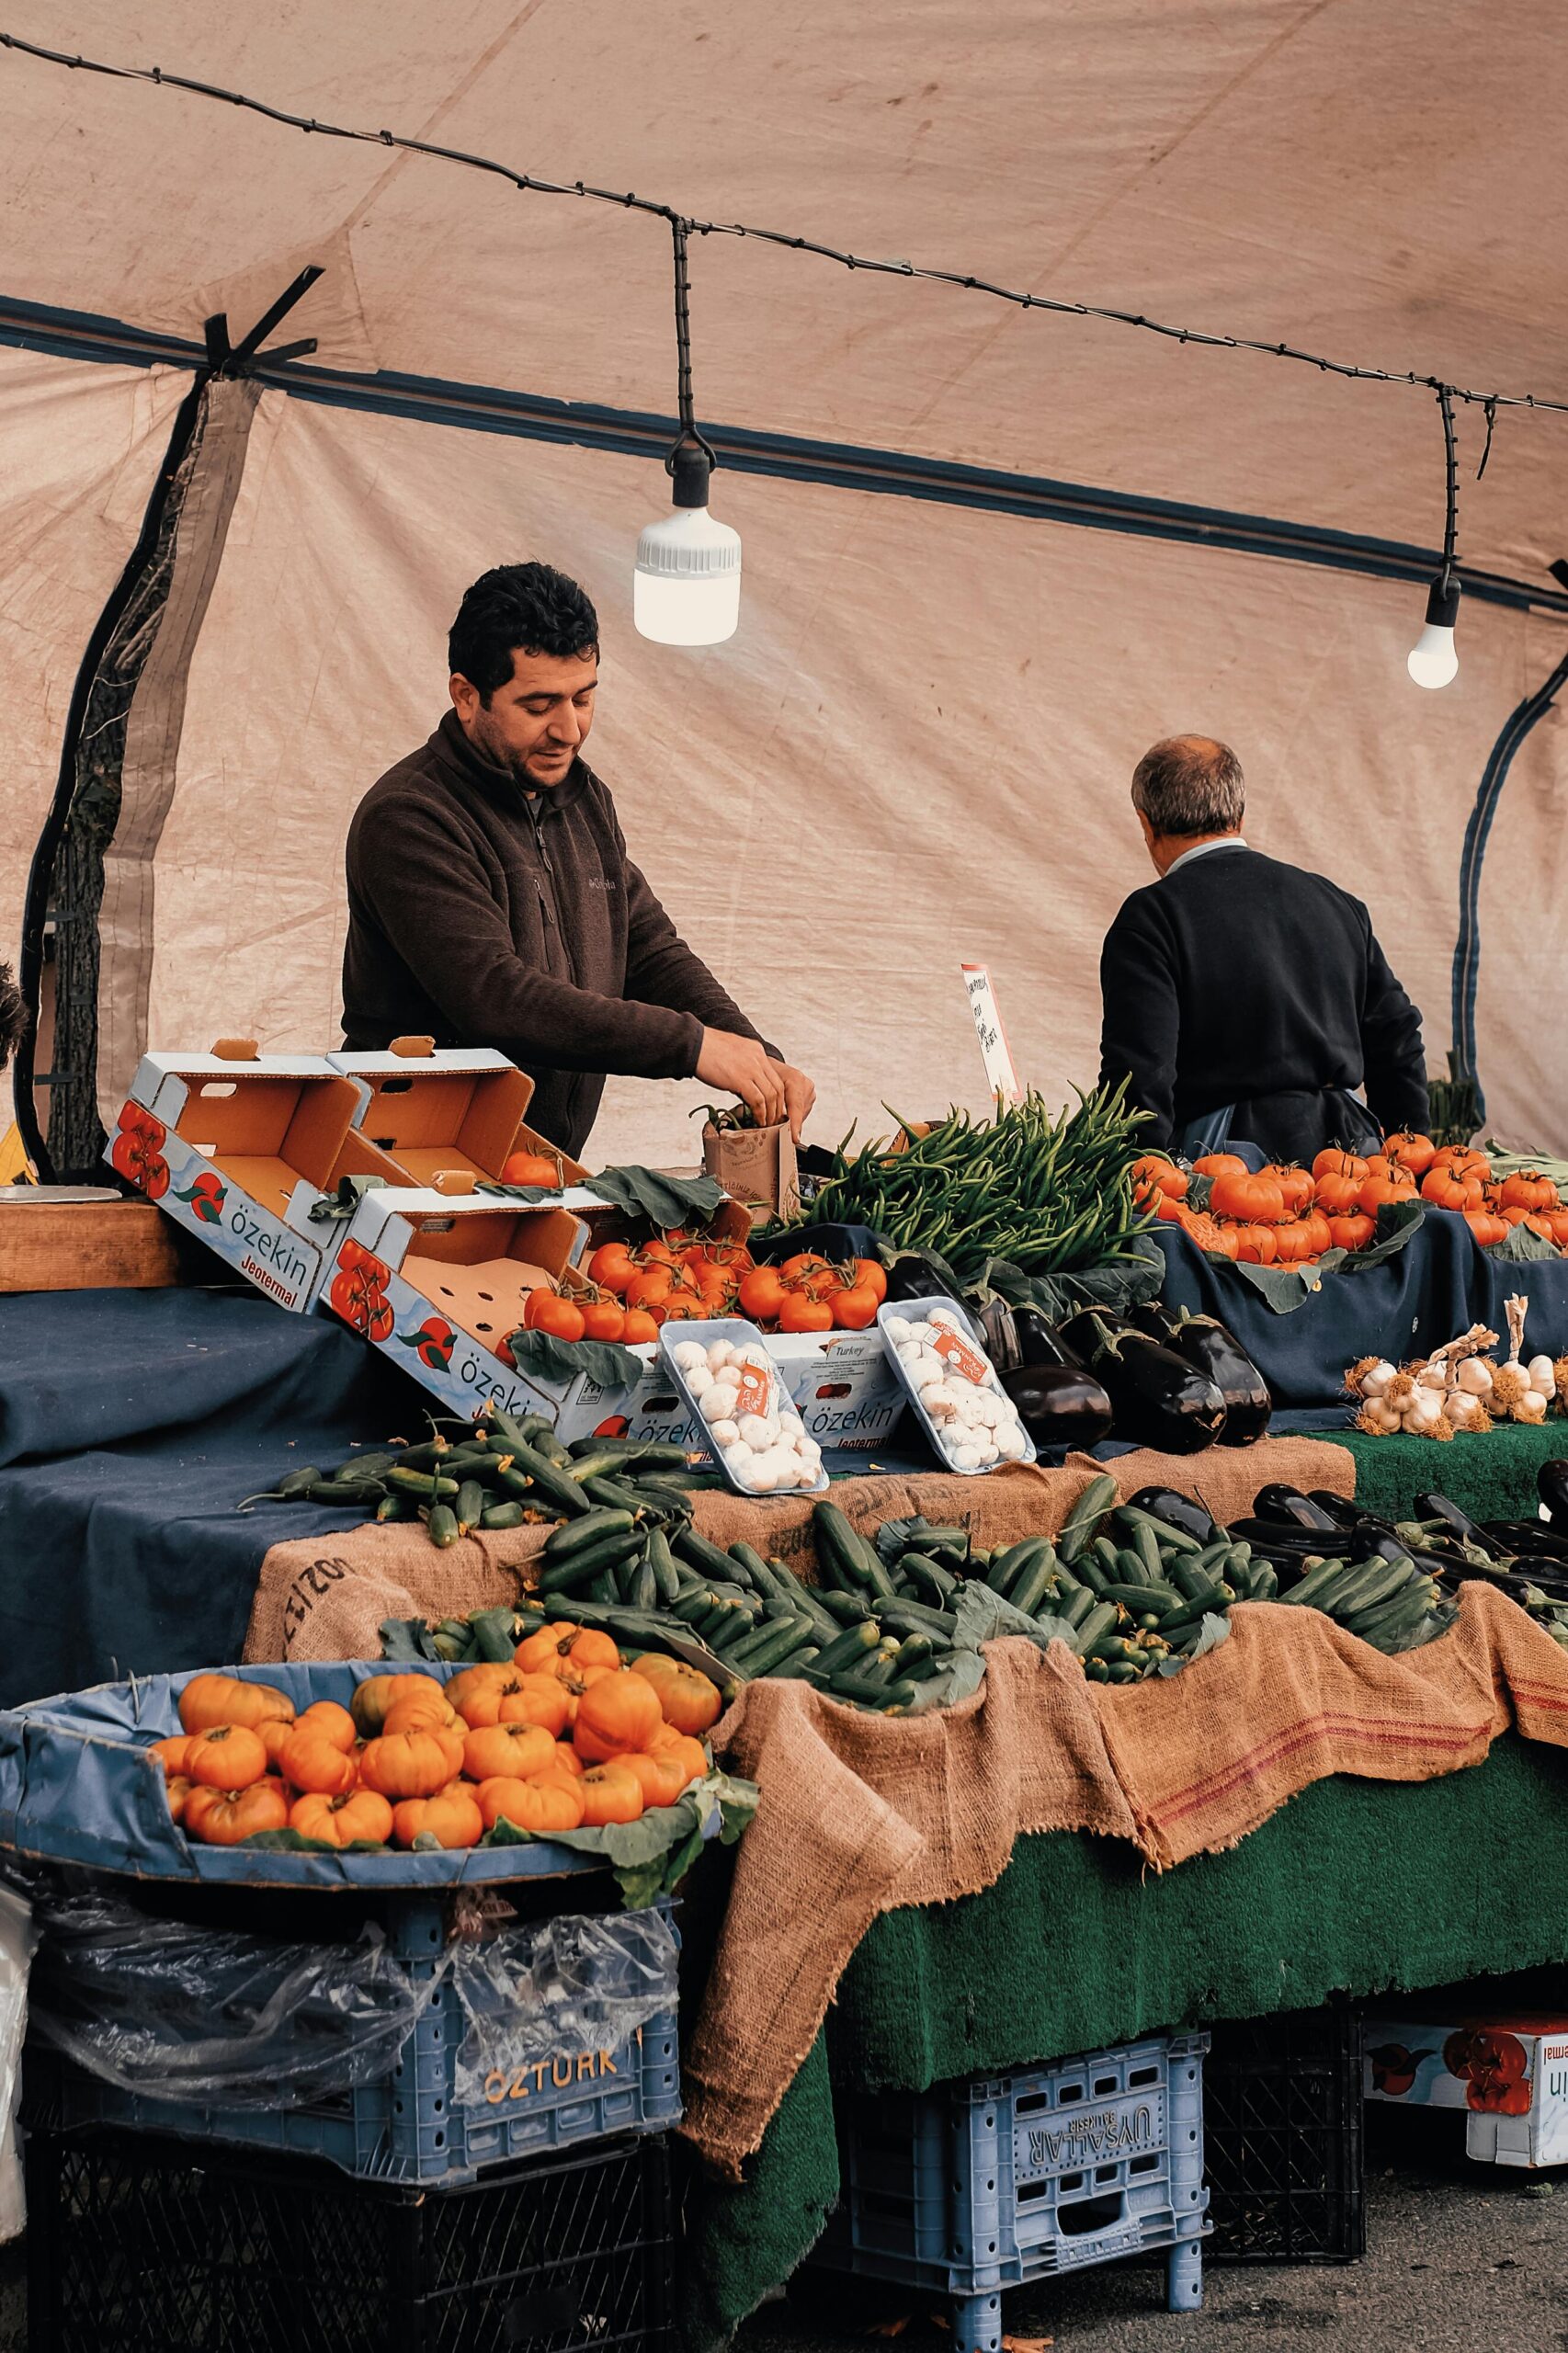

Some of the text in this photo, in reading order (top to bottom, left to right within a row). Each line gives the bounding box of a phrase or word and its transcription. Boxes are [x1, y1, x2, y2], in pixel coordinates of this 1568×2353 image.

[231, 1203, 307, 1287] özekin
[241, 1255, 298, 1308] Jeotermal
[836, 1346, 865, 1357] Turkey
[460, 1351, 531, 1416] özeki
[637, 1417, 701, 1444] özek
[812, 1402, 893, 1433] özekin
[1543, 2045, 1568, 2066] ermal
[1028, 2104, 1152, 2166] UYSALLAR
